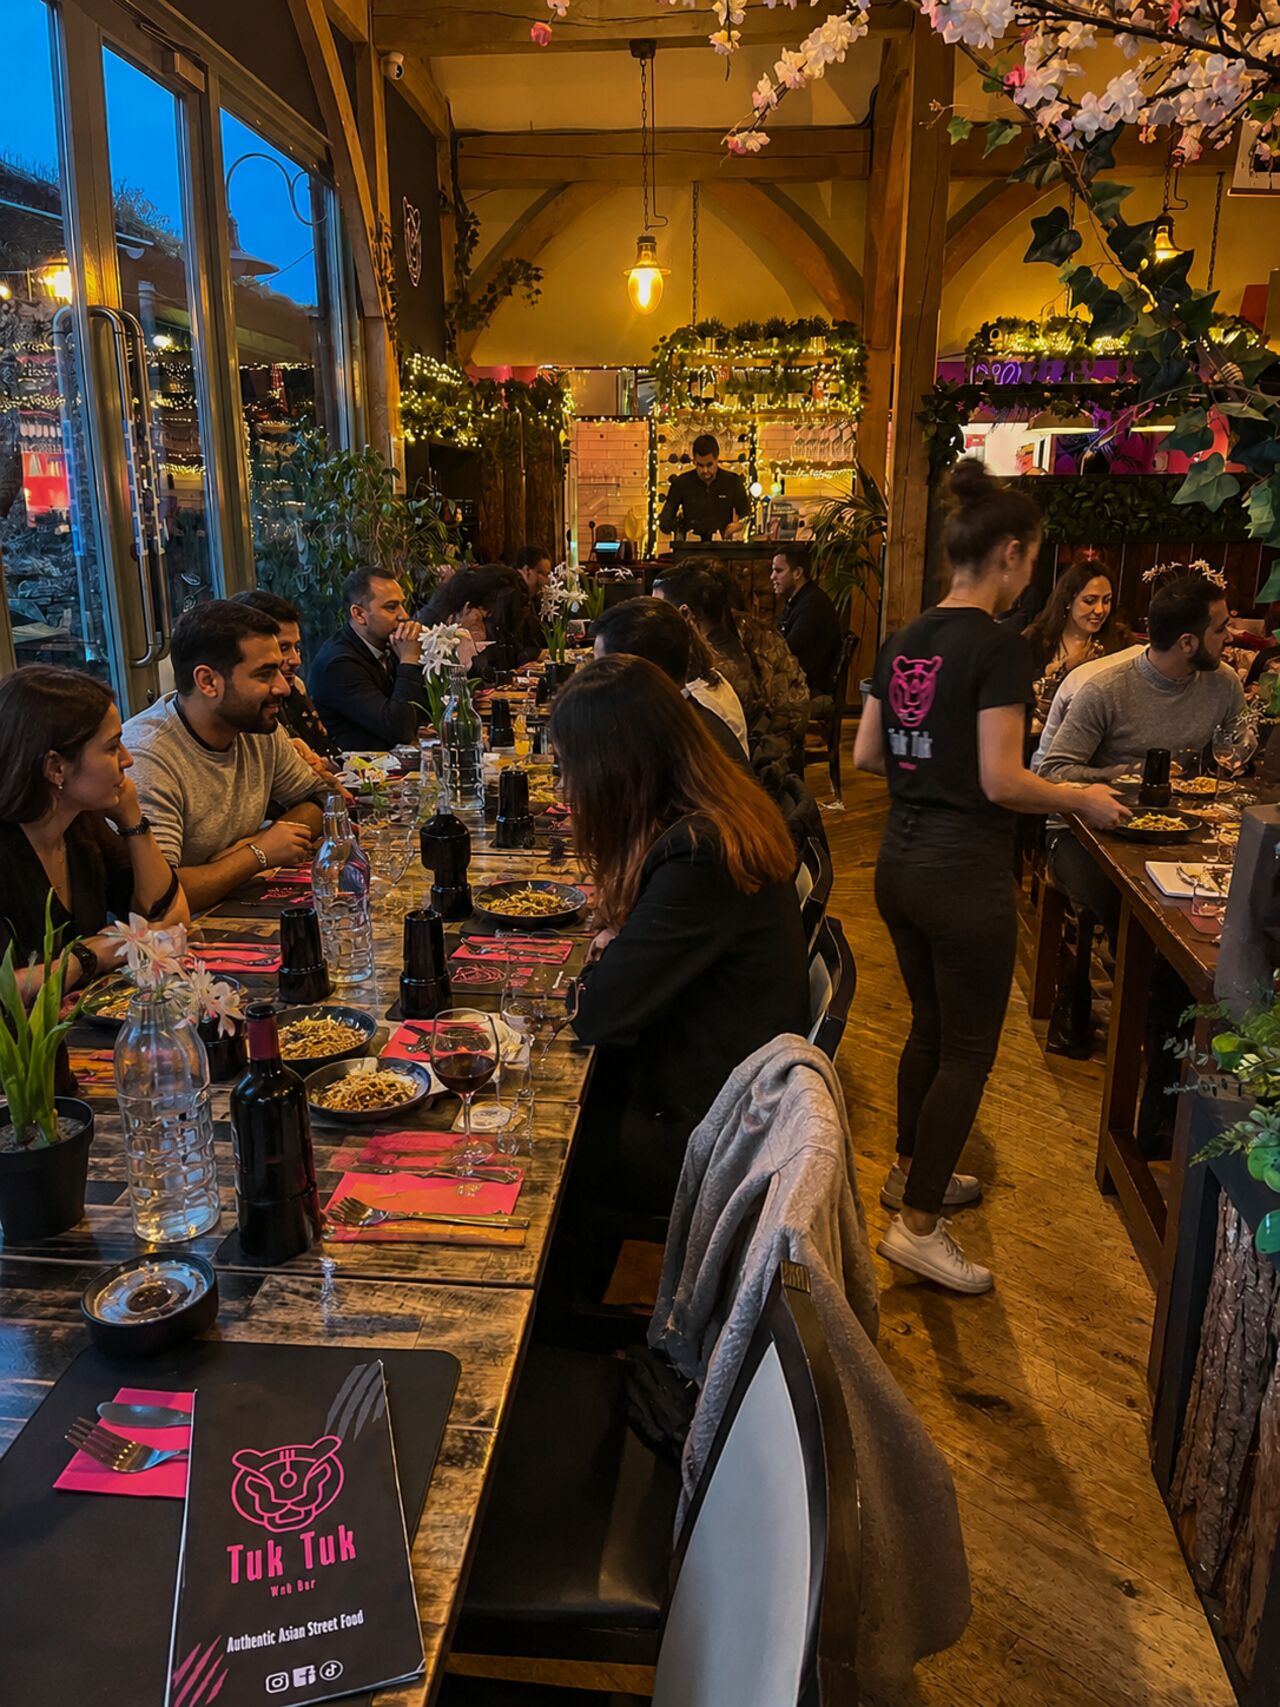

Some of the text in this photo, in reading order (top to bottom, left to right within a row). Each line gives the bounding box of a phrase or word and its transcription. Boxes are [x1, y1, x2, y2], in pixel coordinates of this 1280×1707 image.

[227, 1524, 356, 1584] Tuk Tuk
[226, 1609, 364, 1653] Authentic Asian Street Food
